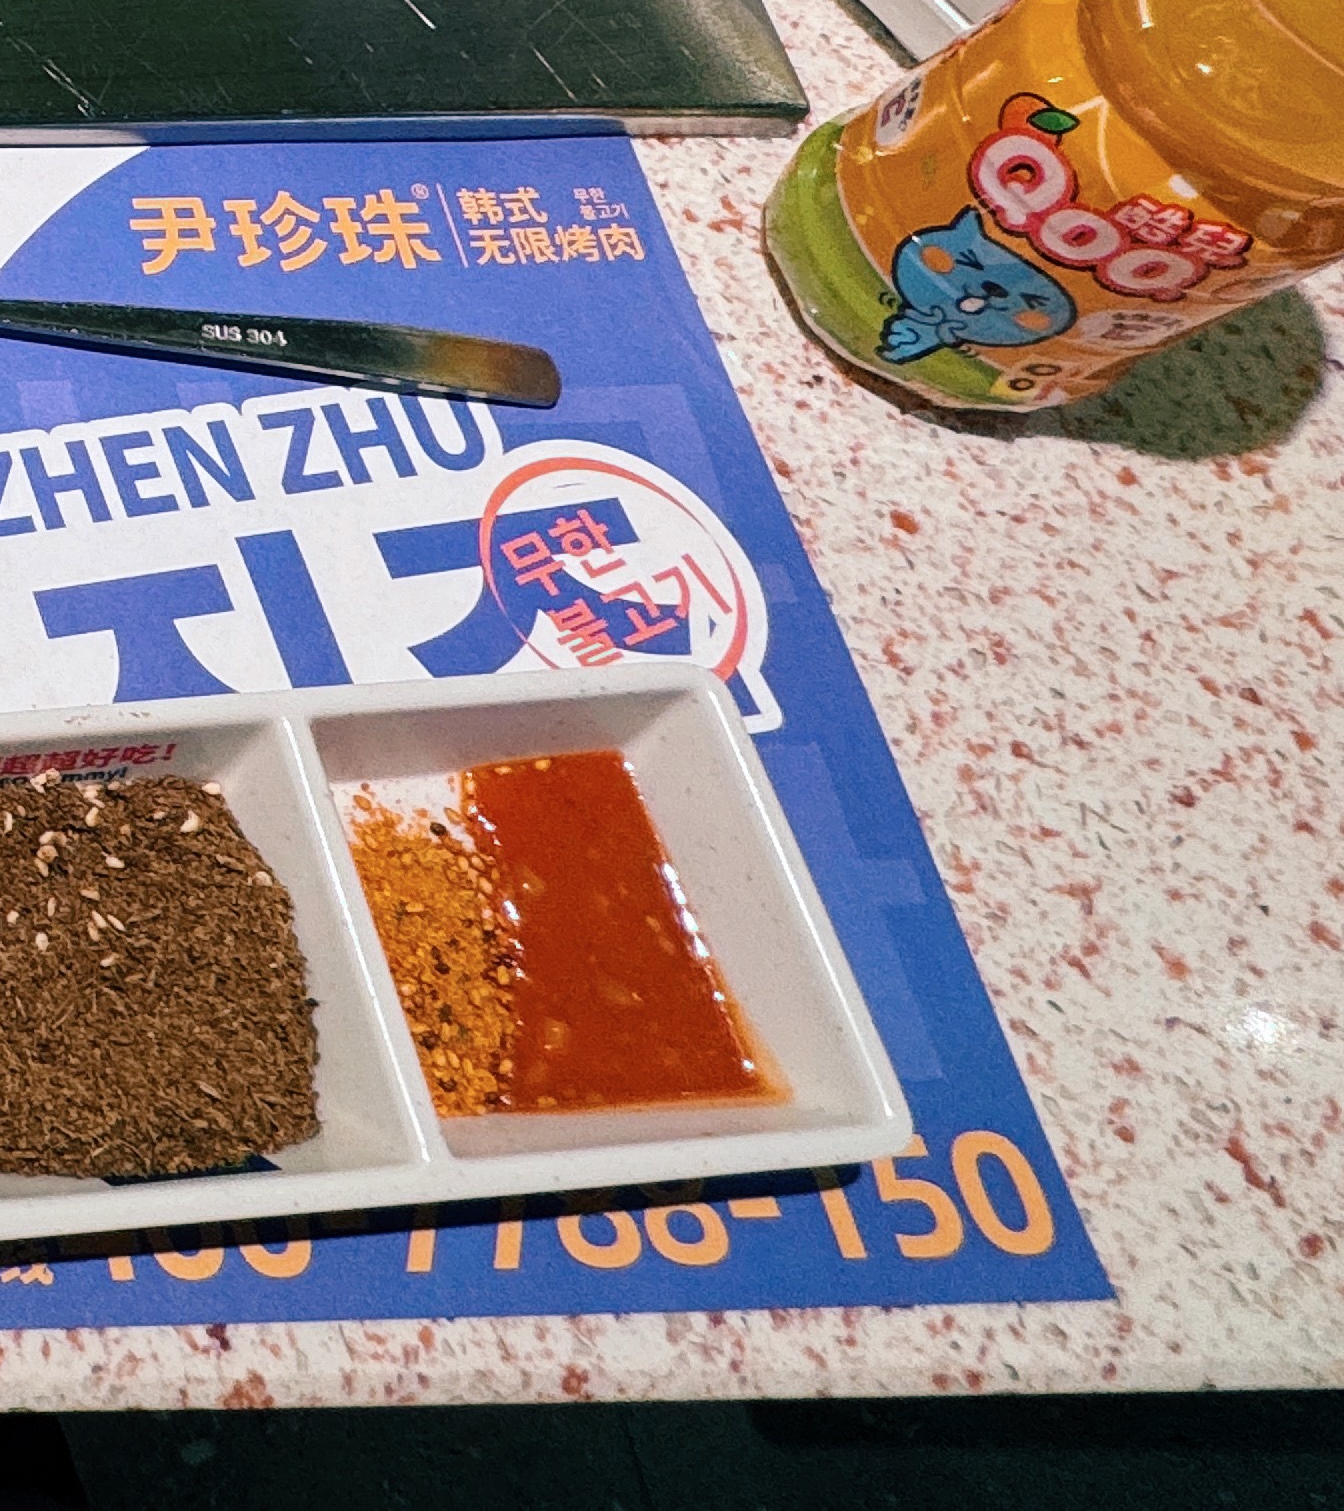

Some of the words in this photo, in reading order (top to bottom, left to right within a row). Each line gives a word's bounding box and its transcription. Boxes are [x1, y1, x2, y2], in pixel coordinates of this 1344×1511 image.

[130, 188, 442, 275] 尹珍珠
[461, 186, 549, 226] 韩式
[475, 224, 645, 264] 无限烤肉
[202, 324, 242, 341] SUS
[246, 328, 288, 347] 304
[258, 392, 486, 495] ZHU
[499, 510, 618, 597] 무한
[550, 553, 735, 666] 불고기
